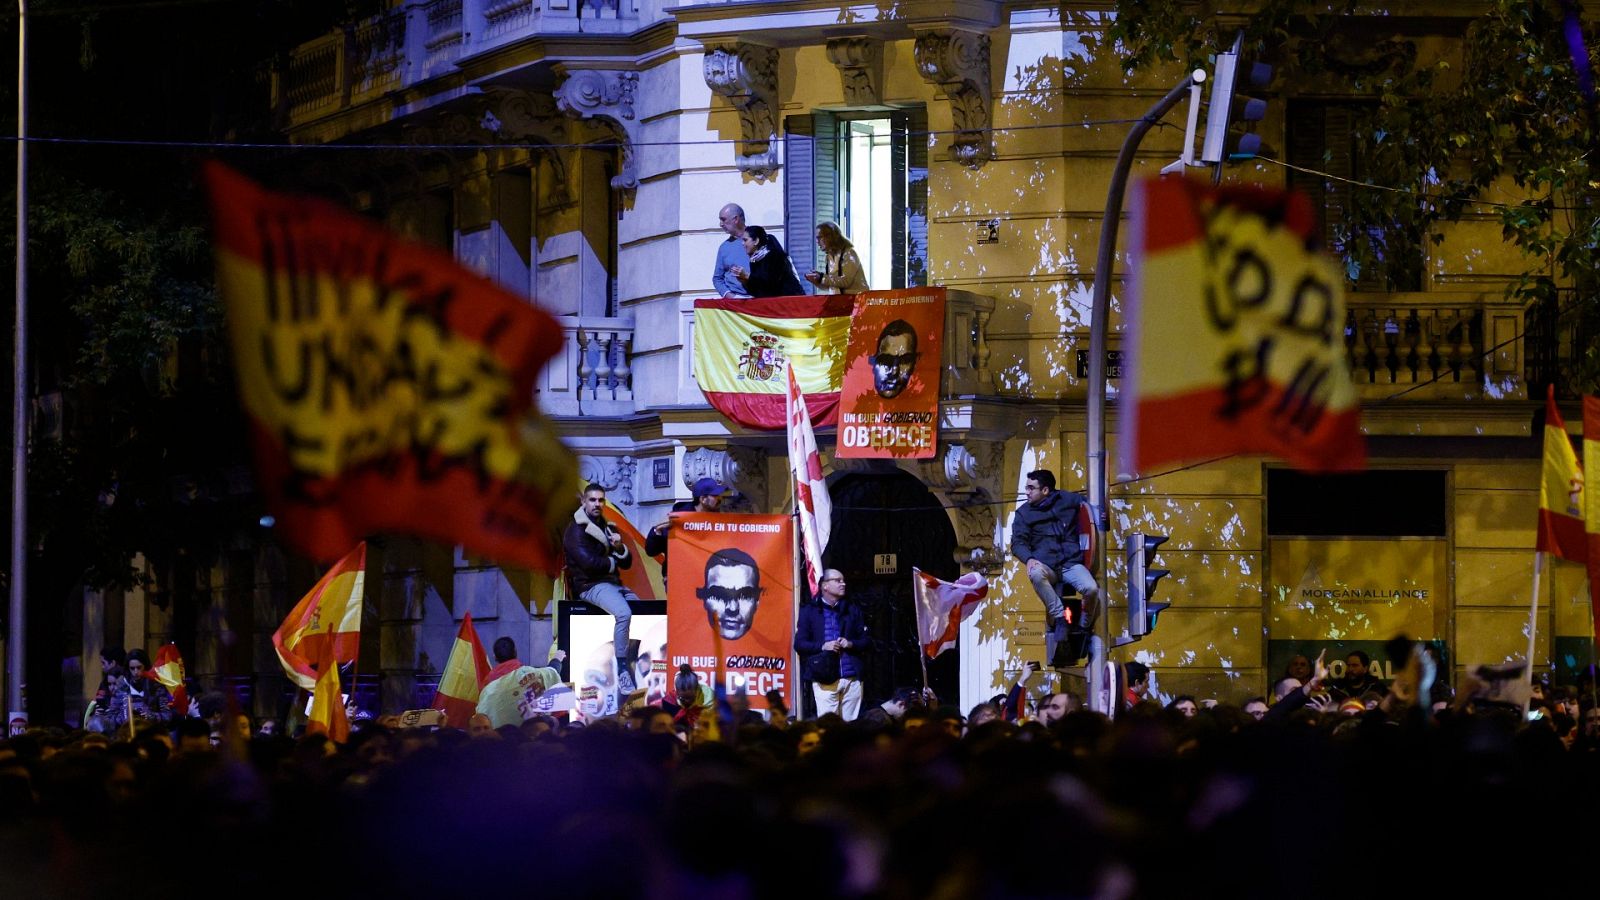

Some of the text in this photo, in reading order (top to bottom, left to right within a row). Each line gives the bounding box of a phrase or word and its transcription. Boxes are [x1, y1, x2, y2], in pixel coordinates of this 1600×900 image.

[890, 298, 899, 306] EN
[843, 411, 933, 424] UN BUEN GOBIERNO
[843, 425, 931, 448] OBEDECE
[683, 521, 781, 533] CONFÍA EN TU GOBIERNO
[672, 656, 689, 667] UN
[725, 655, 786, 670] GOBIERNO
[1322, 659, 1397, 680] OAL
